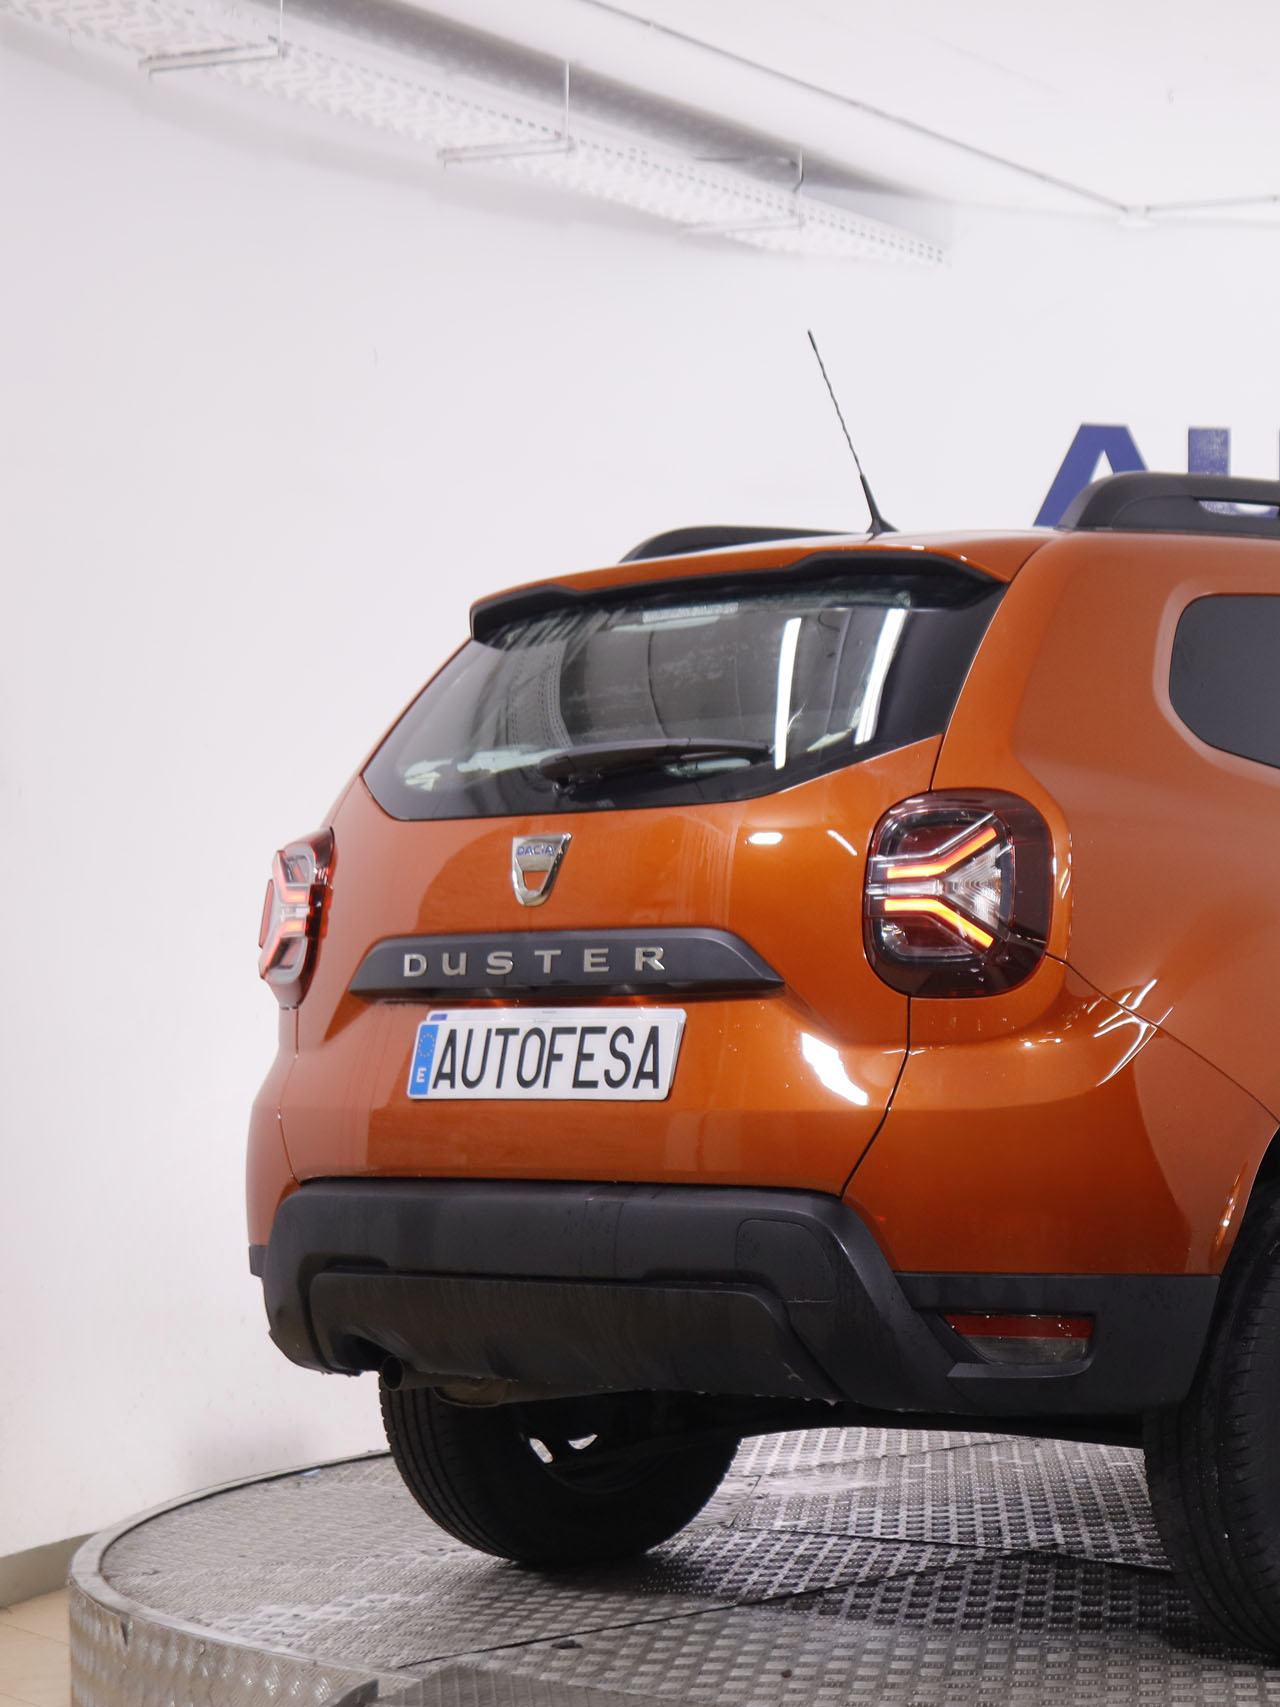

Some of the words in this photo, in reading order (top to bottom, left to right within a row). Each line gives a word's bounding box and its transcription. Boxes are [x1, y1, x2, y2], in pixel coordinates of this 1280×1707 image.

[517, 844, 556, 856] DACIA
[403, 946, 666, 978] DUSTER
[432, 1025, 660, 1090] AUTOFESA
[416, 1067, 427, 1084] E
